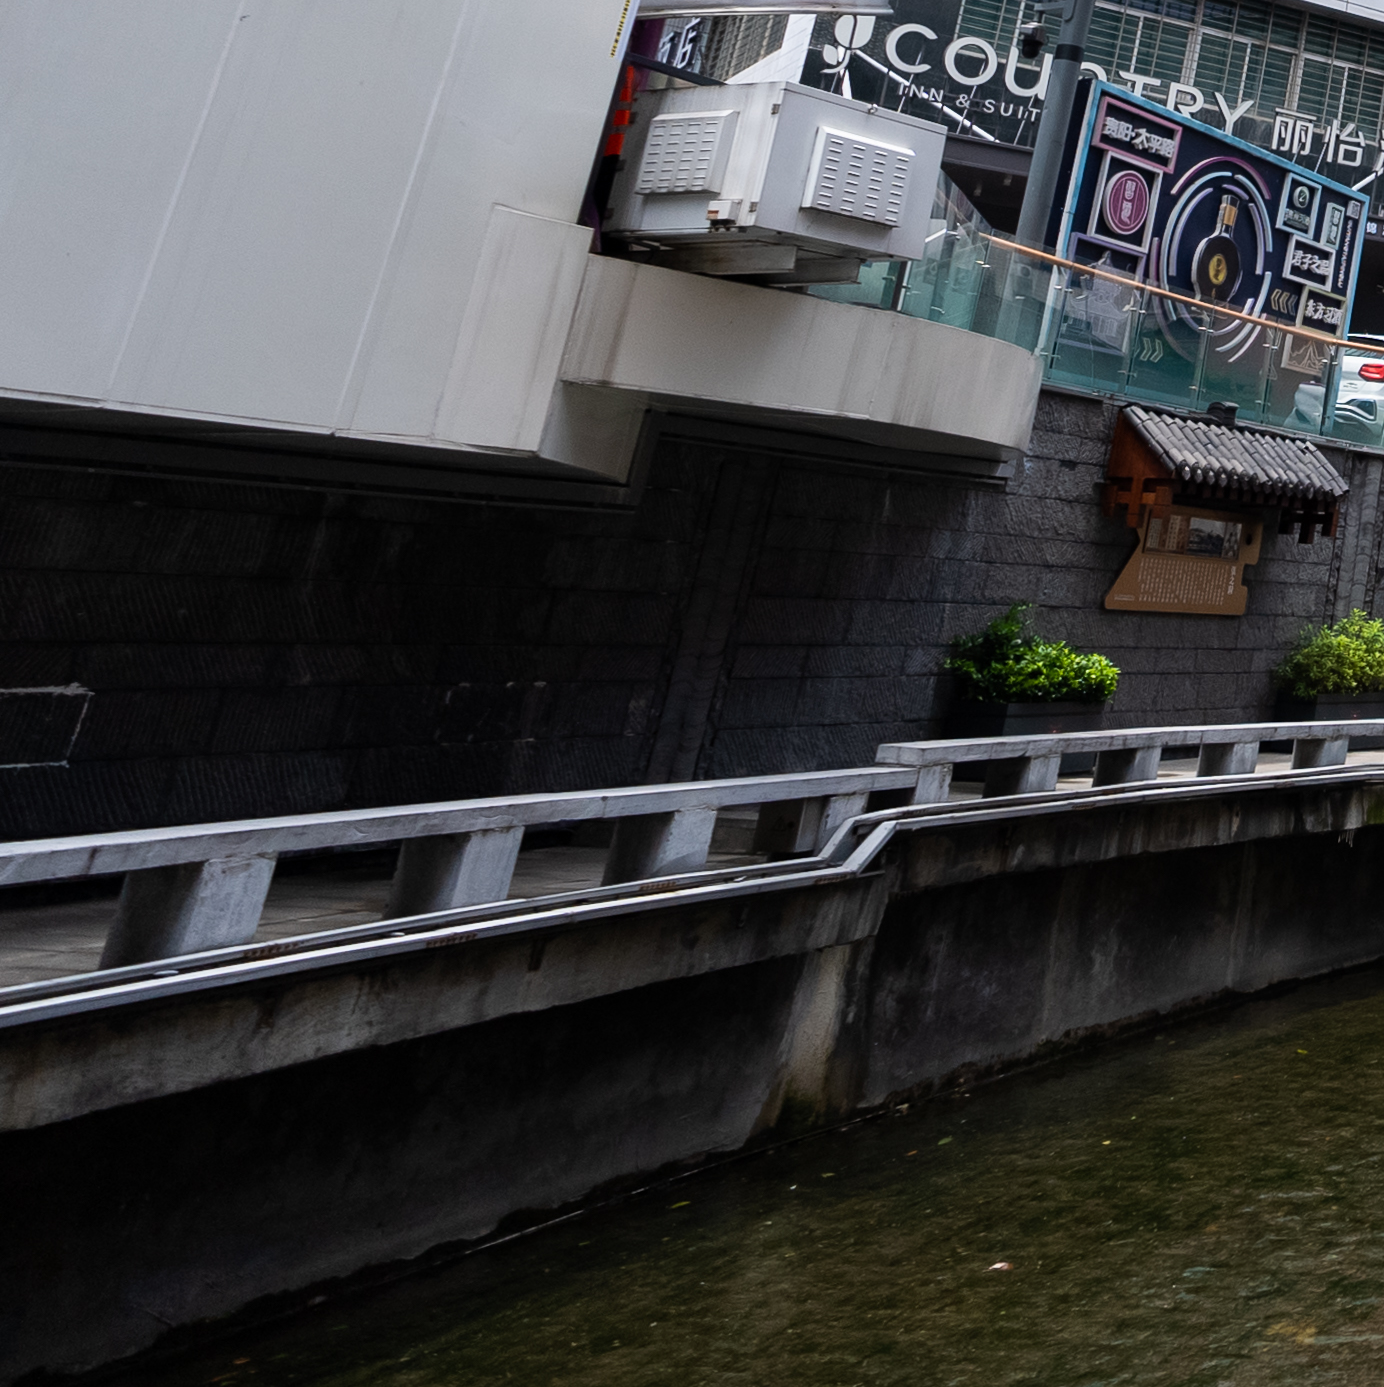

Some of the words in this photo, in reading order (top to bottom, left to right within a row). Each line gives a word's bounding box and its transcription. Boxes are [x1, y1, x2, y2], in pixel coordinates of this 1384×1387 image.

[885, 23, 1255, 135] COUTRY
[899, 82, 944, 104] INN
[955, 93, 971, 108] &
[983, 98, 1042, 123] SUIT
[1292, 250, 1331, 276] 君子之品
